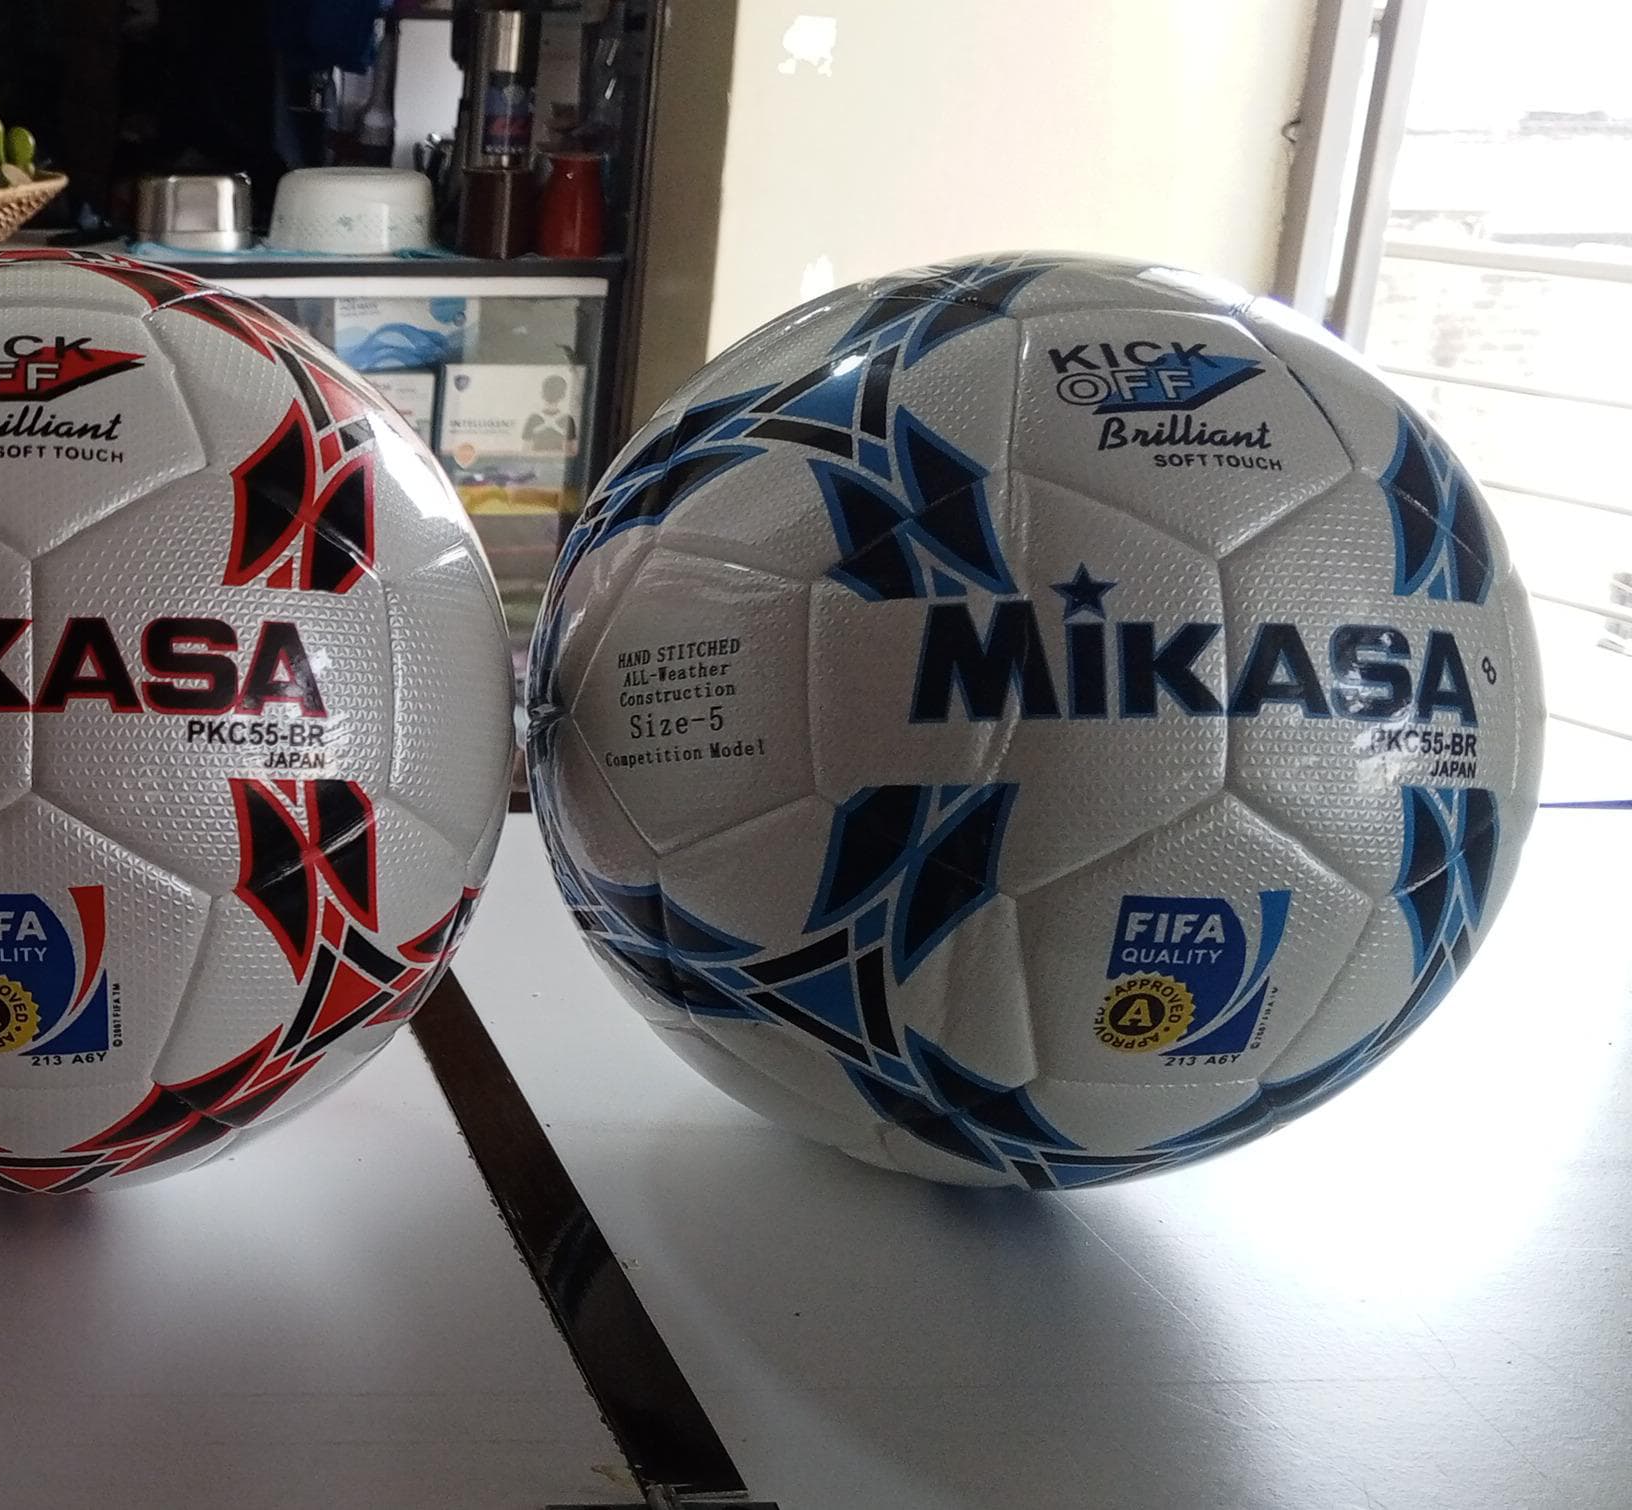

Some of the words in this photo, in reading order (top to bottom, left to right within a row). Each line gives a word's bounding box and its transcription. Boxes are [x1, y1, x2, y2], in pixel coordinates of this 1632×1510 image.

[1048, 341, 1220, 374] KICK
[1056, 368, 1194, 406] OFF
[1098, 414, 1271, 450] Brilliant
[54, 446, 123, 463] TOUCH
[1154, 454, 1207, 468] SOFT
[1213, 454, 1282, 471] TOUCH
[617, 649, 651, 669] HAND
[656, 638, 741, 663] STITCHED
[623, 662, 732, 688] ALL-Weather
[619, 682, 735, 708] Construction
[187, 720, 325, 747] PKC55-BR
[630, 705, 724, 740] Size-5
[605, 747, 703, 769] Competition
[710, 739, 765, 759] Model
[1371, 729, 1477, 757] PKC55-BR
[264, 752, 325, 769] JAPAN
[1430, 761, 1476, 779] JAPAN
[1124, 912, 1226, 944] FIFA
[1121, 947, 1223, 964] QUALITY
[1115, 978, 1184, 1023] APPROVED
[31, 1056, 62, 1066] 213
[72, 1051, 107, 1064] A6Y
[1165, 1056, 1196, 1066] 213
[1204, 1054, 1241, 1065] A6Y
